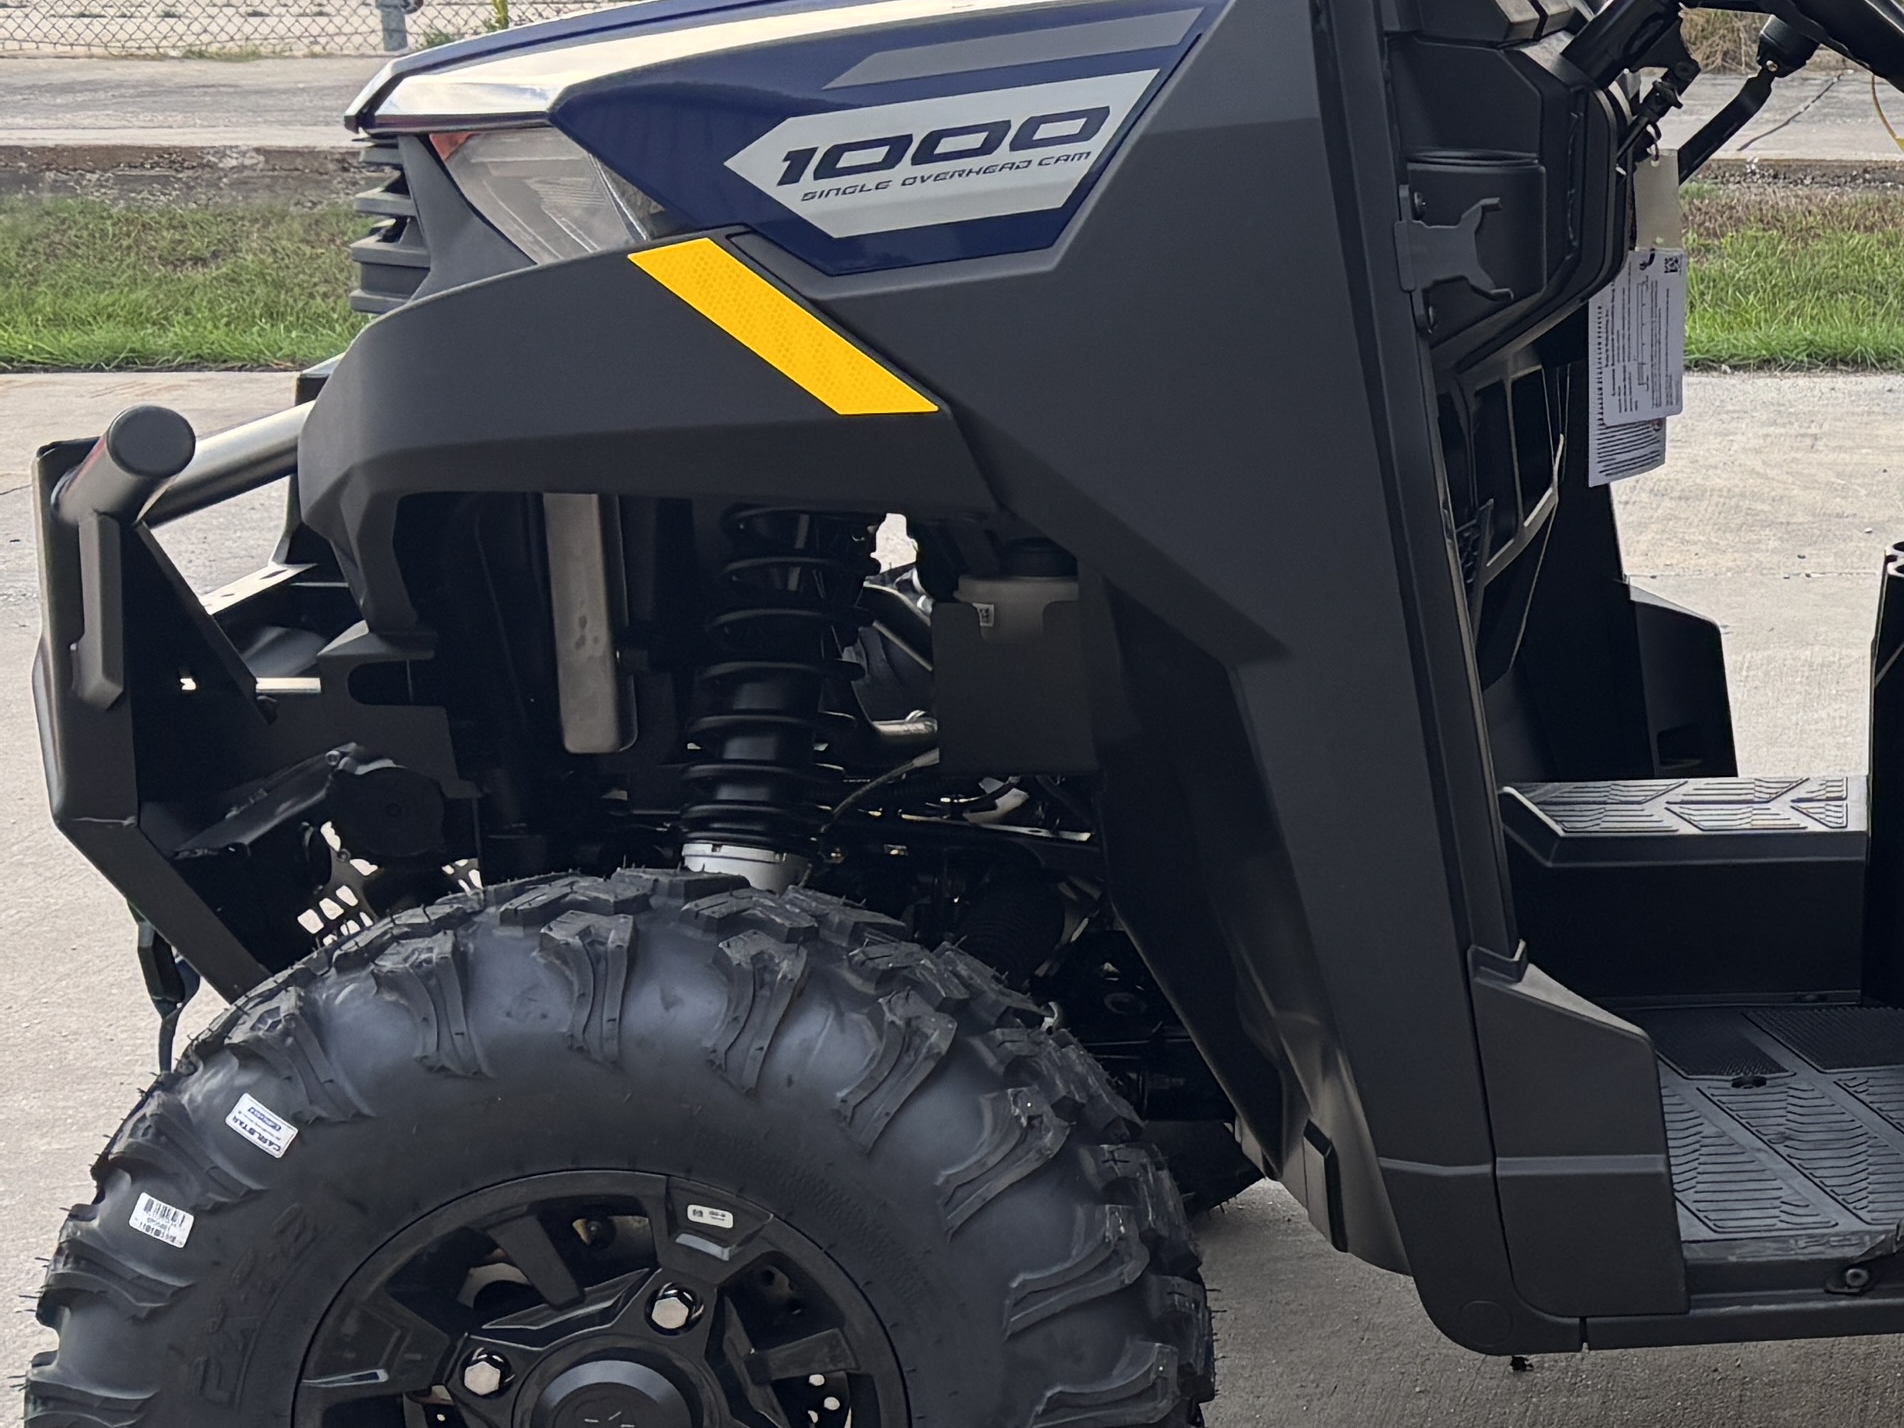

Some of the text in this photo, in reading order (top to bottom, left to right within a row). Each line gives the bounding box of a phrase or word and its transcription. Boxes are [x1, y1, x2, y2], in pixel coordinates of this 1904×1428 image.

[776, 104, 1111, 187] 1000
[800, 150, 1094, 202] SINGLE OVERHEAD CAM
[232, 1115, 282, 1152] CARLSTAR
